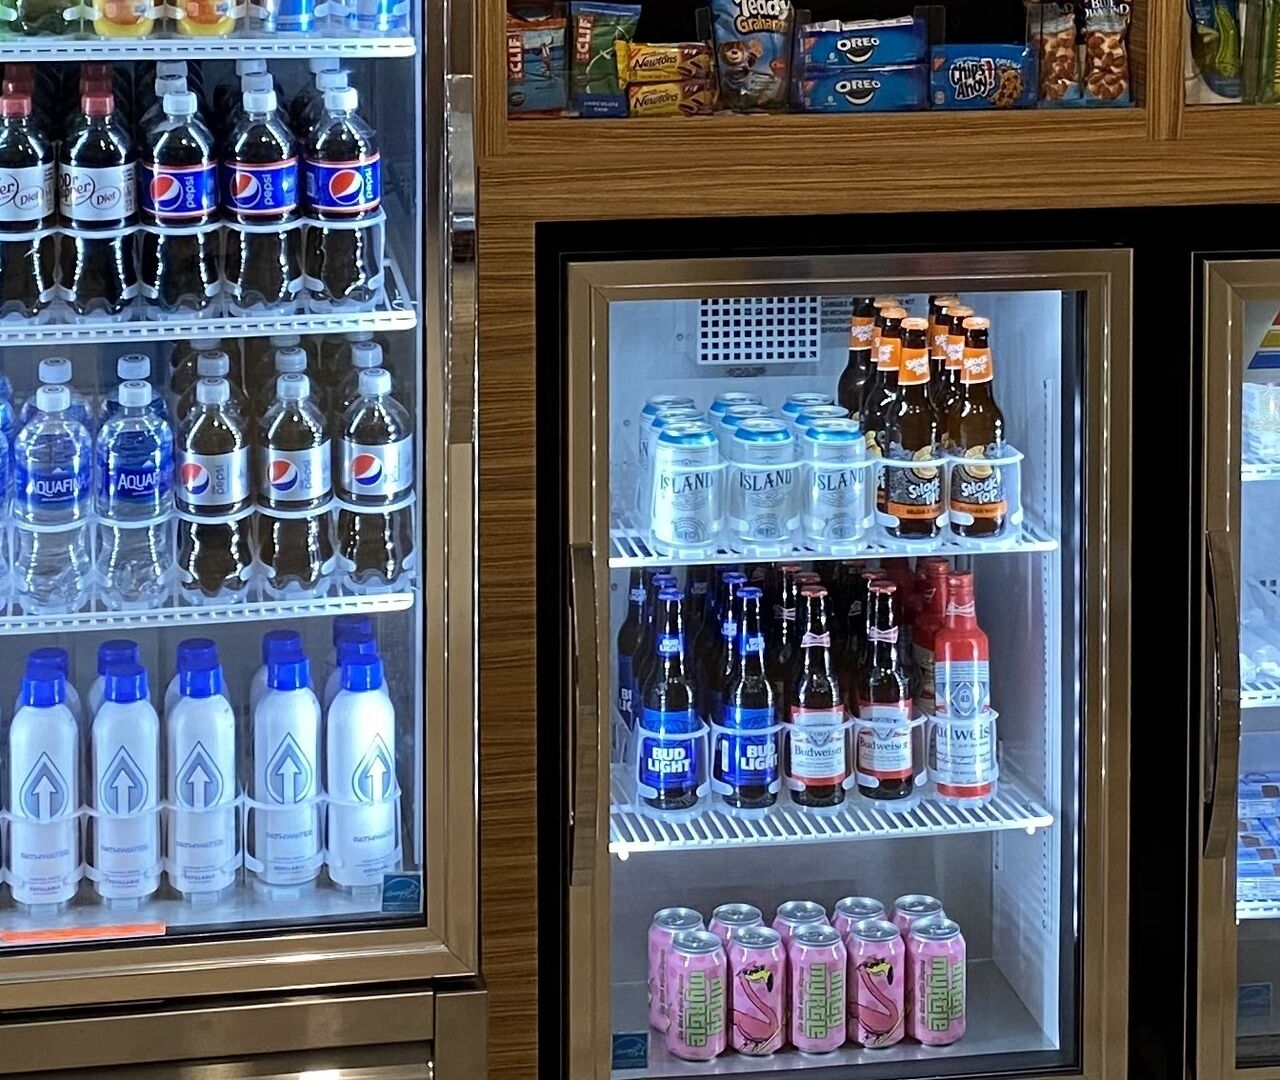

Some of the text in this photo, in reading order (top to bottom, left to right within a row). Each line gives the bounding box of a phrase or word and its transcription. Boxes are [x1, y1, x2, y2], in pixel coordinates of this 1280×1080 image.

[577, 17, 593, 52] CLIF
[836, 37, 880, 52] OREO
[508, 38, 521, 74] CLIF
[633, 54, 677, 69] Newtons
[951, 60, 987, 84] Chips
[835, 79, 881, 93] OREO
[634, 94, 679, 109] Newtons
[20, 191, 39, 206] Diet
[96, 191, 116, 206] Diet
[185, 175, 196, 208] pepsi
[263, 174, 275, 206] pepsi
[215, 464, 225, 495] pepsi
[303, 460, 312, 490] pepsi
[661, 472, 713, 494] ISLAND
[739, 469, 793, 492] ISLAND
[813, 469, 864, 492] ISLAND
[909, 478, 940, 499] SHOCK
[961, 477, 998, 497] SHOCK
[975, 491, 998, 505] TOP
[652, 747, 687, 761] BUD
[746, 744, 776, 758] BUD
[794, 744, 843, 757] Budweiser
[648, 758, 692, 773] LIGHT
[740, 754, 778, 770] LIGHT
